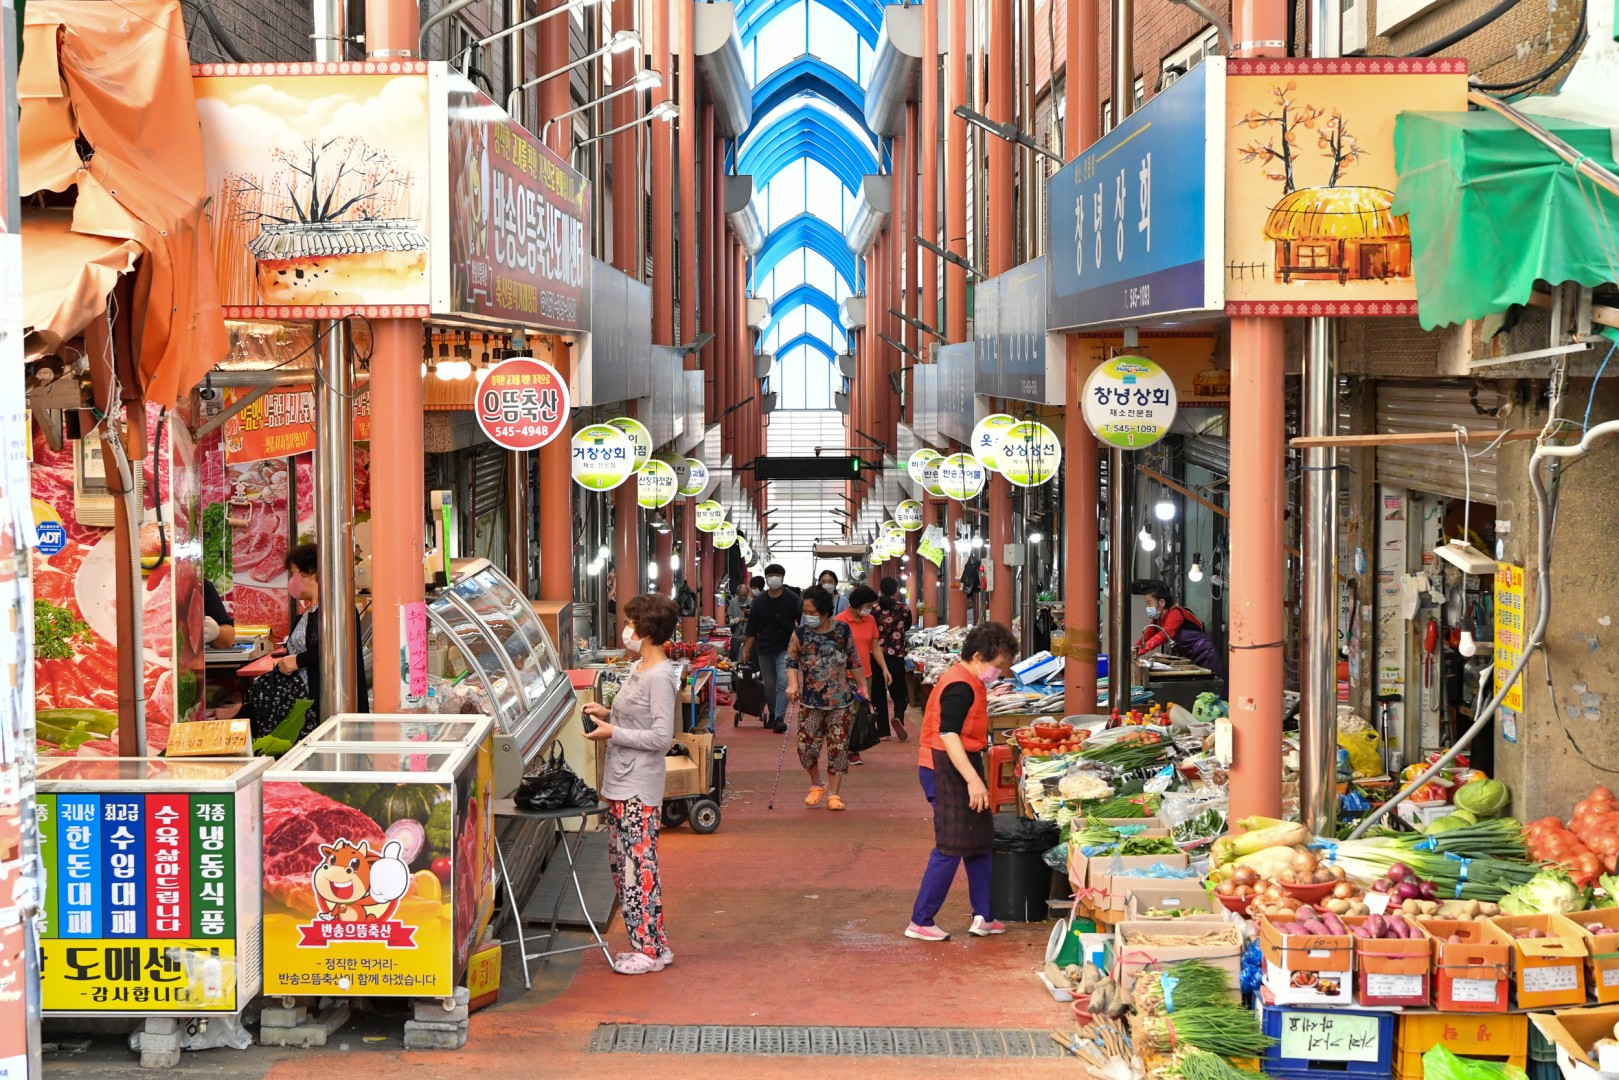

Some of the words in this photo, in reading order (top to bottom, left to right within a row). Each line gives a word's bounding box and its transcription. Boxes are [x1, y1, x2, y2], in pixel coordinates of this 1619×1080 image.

[1074, 152, 1151, 276] 창녕상회
[1094, 386, 1169, 406] 창녕상회
[484, 389, 558, 422] 으뜸축산
[1110, 408, 1153, 418] 채소전문점
[495, 426, 549, 437] 545-4948
[1104, 424, 1157, 434] T.545-1093
[1128, 434, 1133, 444] 1
[573, 447, 626, 460] 거창상회
[1002, 444, 1055, 457] 싱싱생선
[40, 532, 61, 544] ADT
[61, 804, 96, 822] 국내산
[104, 804, 139, 822] 최고급
[196, 804, 226, 822] 각종
[66, 825, 92, 934] 한돈대패
[110, 826, 137, 934] 수입대패
[198, 826, 226, 935] 냉동식품
[321, 922, 392, 939] 반송으뜸축산
[64, 946, 220, 983] 도매센
[278, 972, 354, 987] 반송으뜸축산이
[357, 973, 380, 986] 함께
[382, 973, 437, 986] 하겠습니다
